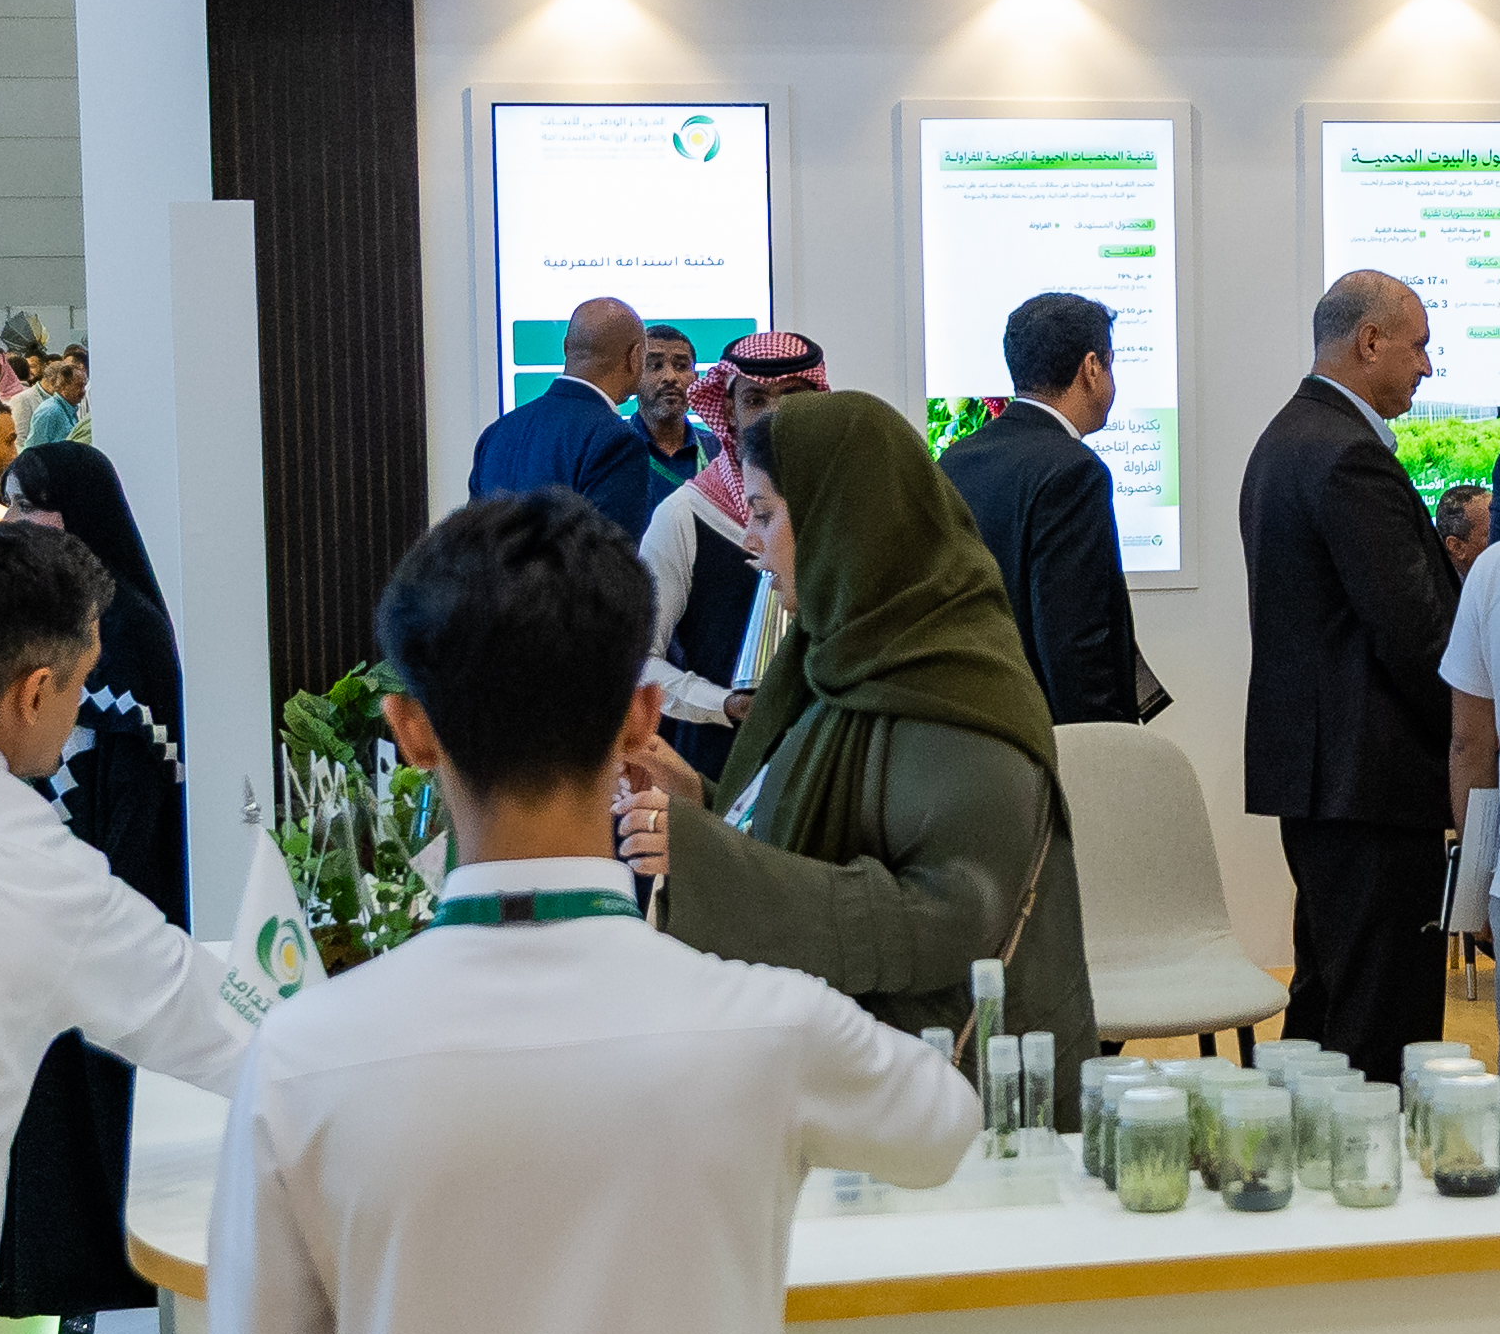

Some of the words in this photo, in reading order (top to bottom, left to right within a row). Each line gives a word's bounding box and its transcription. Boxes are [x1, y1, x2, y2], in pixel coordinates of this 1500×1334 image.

[945, 151, 982, 164] للفراولة
[986, 151, 1027, 165] البكتيرية
[1032, 151, 1068, 164] الحيوية
[1072, 151, 1123, 164] المخصبات
[1127, 151, 1154, 164] تقنية
[1352, 148, 1421, 167] المحمية
[1428, 149, 1477, 168] والبيوت
[544, 256, 609, 271] المعرفية
[616, 255, 678, 267] استدامة
[684, 256, 724, 269] مكتبة
[1442, 300, 1447, 308] 3
[1438, 347, 1444, 355] 3
[1436, 369, 1446, 377] 12
[1129, 419, 1160, 433] بكتيريا
[1094, 441, 1128, 455] إنتاجية
[1132, 441, 1160, 454] تدعم
[1124, 461, 1160, 475] الفراولة
[1117, 482, 1161, 496] وخصوبة
